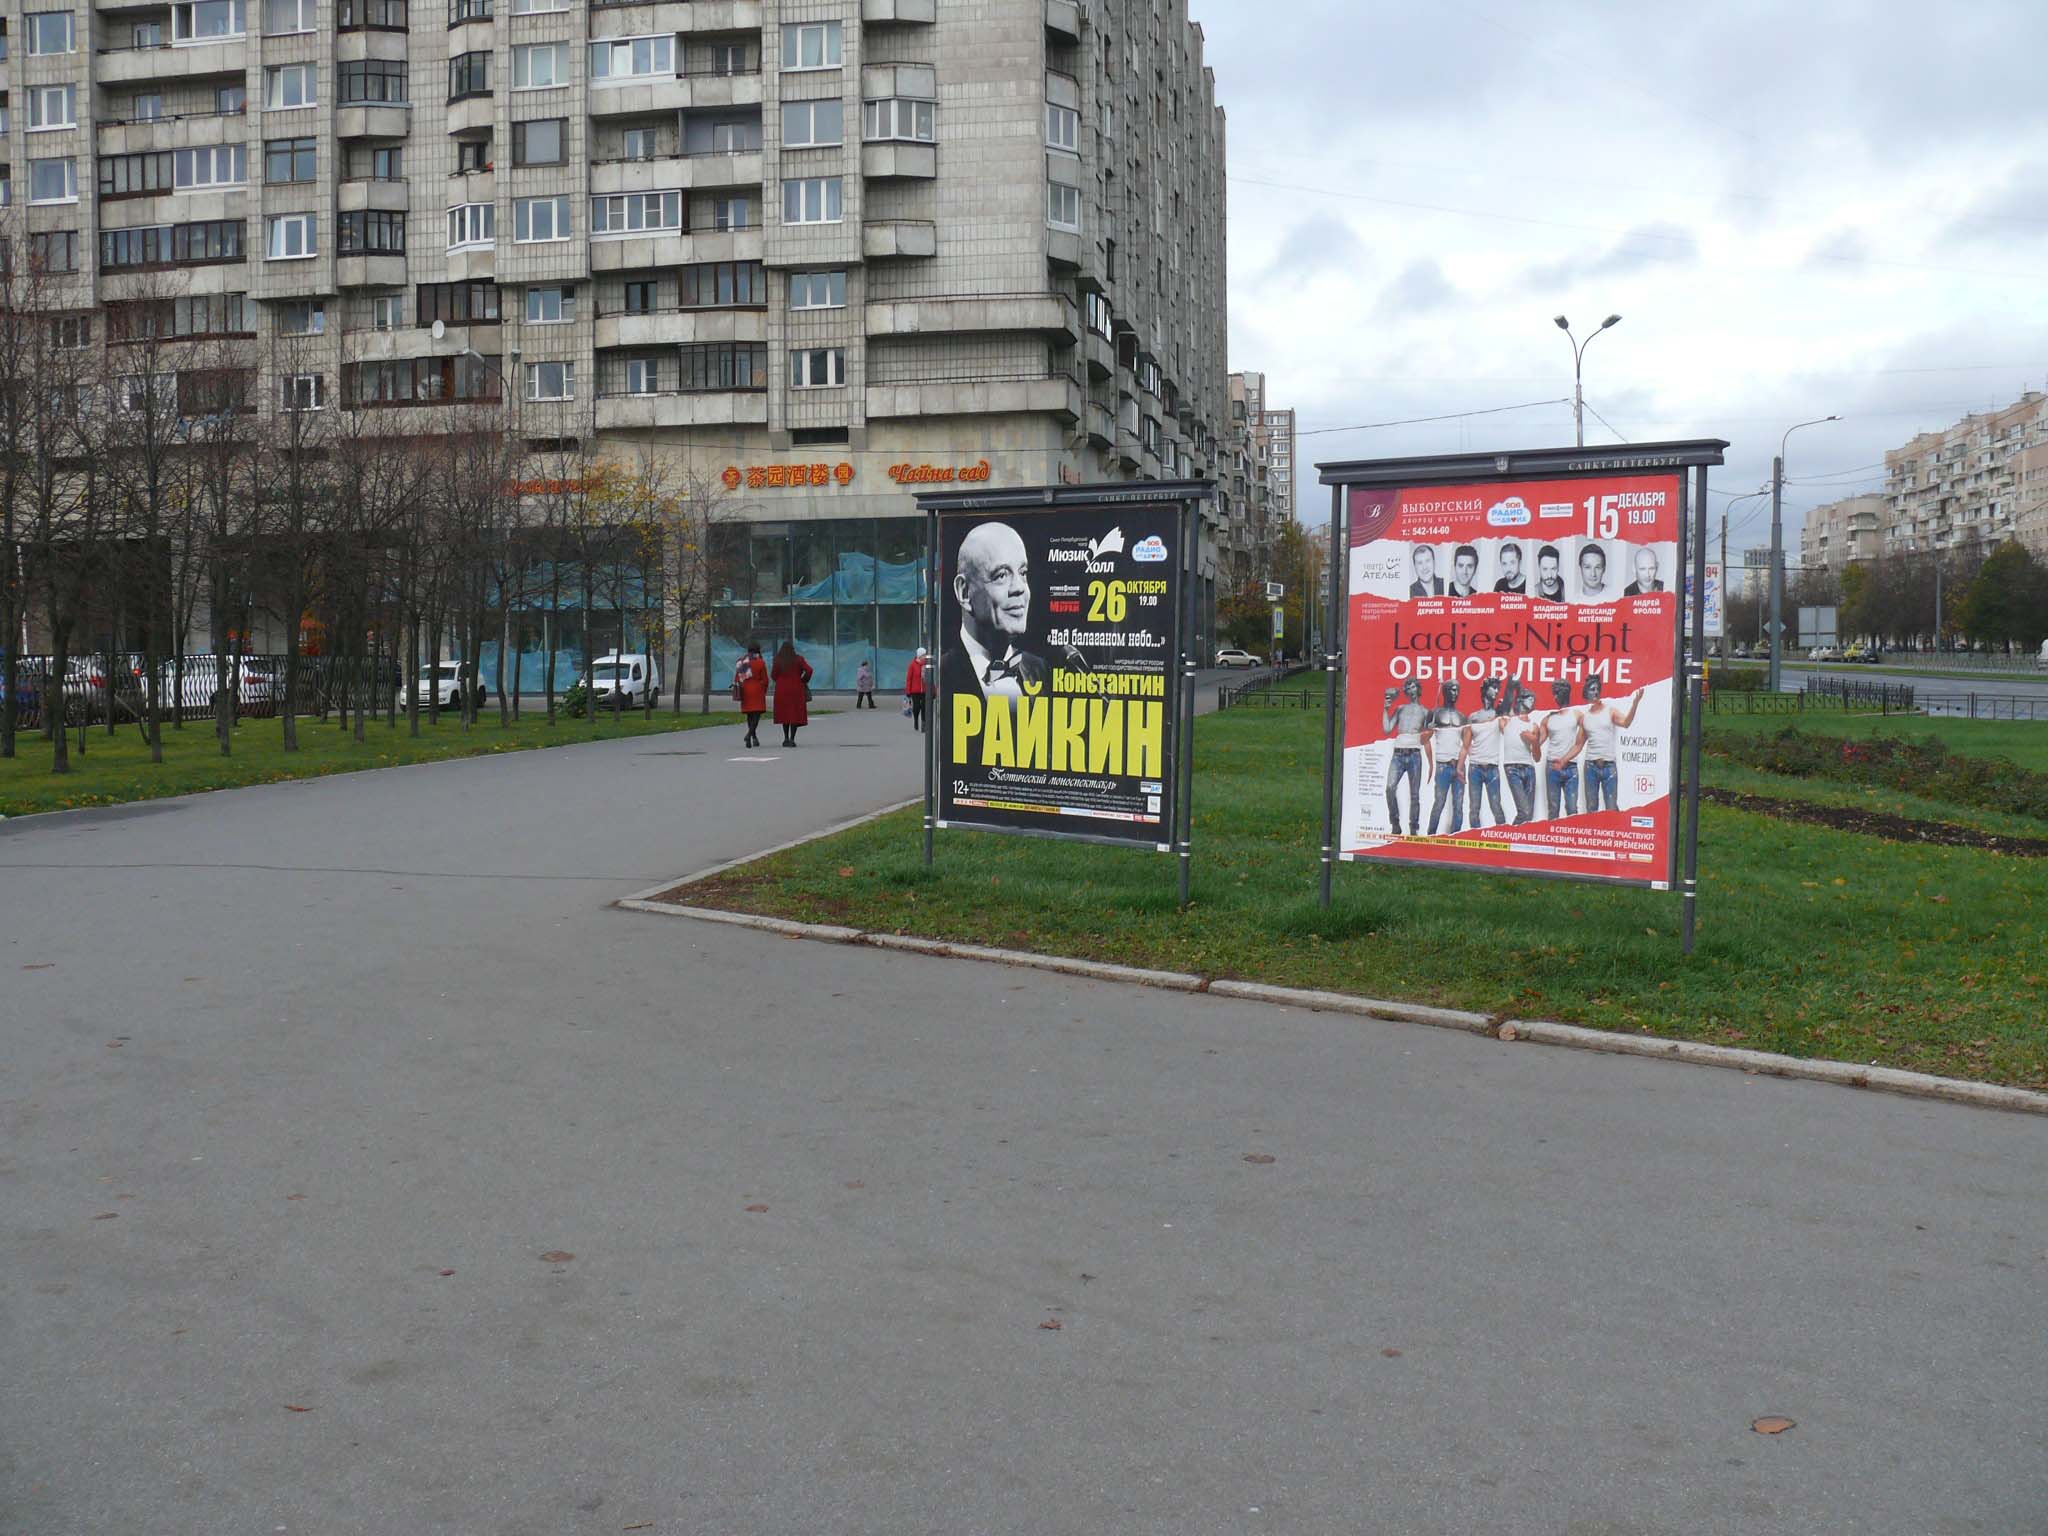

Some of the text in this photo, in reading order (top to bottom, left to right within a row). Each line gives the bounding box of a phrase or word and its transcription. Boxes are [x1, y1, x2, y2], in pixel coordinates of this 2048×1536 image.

[1568, 457, 1684, 471] САНКТ-ПЕТЕРБУРГ
[746, 463, 830, 488] 茶园酒楼
[888, 460, 992, 484] Чайна сад
[1402, 498, 1483, 514] ВЫБОРГСКИЙ
[1491, 508, 1523, 516] РАДИО
[1583, 495, 1619, 540] 15
[1618, 491, 1666, 509] ДЕКАБРЯ
[1627, 509, 1656, 524] 19.00
[1048, 549, 1090, 562] Мюзик
[1085, 561, 1115, 573] Холл
[1087, 580, 1127, 622] 26
[1126, 581, 1167, 594] ОКТЯБРЯ
[1139, 595, 1158, 606] 19.00
[1633, 598, 1660, 607] АНДРЕЙ
[1578, 608, 1616, 616] АЛЕКСАНДР
[1633, 607, 1662, 615] ФРОЛОВ
[1047, 628, 1070, 646] «Над
[1071, 628, 1126, 647] балаганом
[1389, 655, 1633, 684] ОБНОВЛЕНИЕ
[1052, 667, 1165, 696] Константин
[952, 681, 1163, 778] РАЙКИН
[1620, 735, 1658, 747] МУЖСКАЯ
[1621, 751, 1657, 763] КОМЕДИЯ
[987, 767, 1047, 785] Поэтический
[952, 779, 970, 795] 12+
[1636, 777, 1656, 792] 18+
[1480, 829, 1655, 851] АЛЕКСАНДРА ВЕЛЕСКЕВИЧ, ВАЛЕРИЙ ЯРЁМЕНКО
[1555, 827, 1592, 836] СПЕКТАКЛЕ
[1593, 830, 1615, 838] ТАКЖЕ
[1615, 831, 1656, 841] УЧАСТВУЮТ
